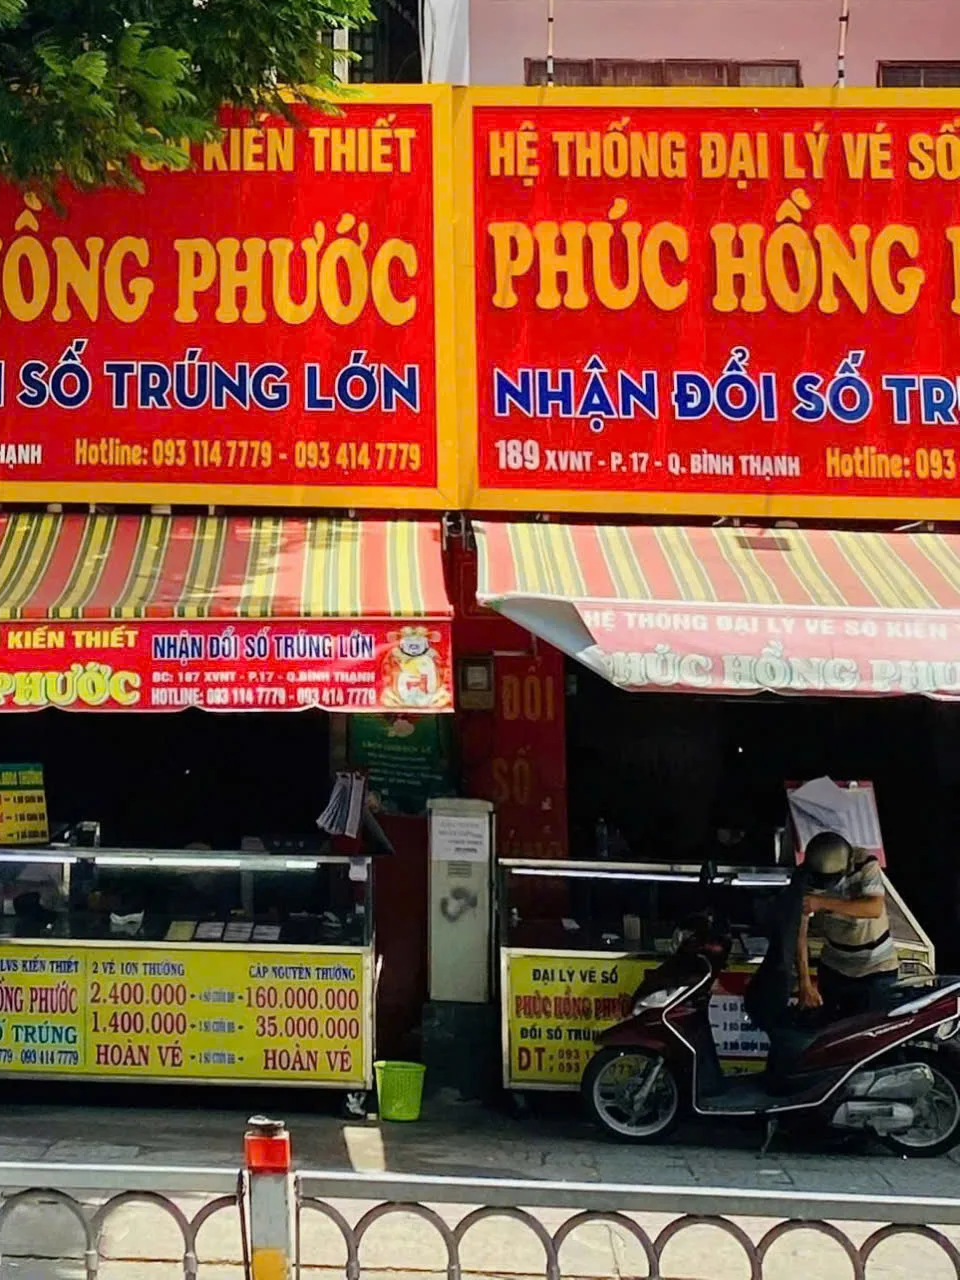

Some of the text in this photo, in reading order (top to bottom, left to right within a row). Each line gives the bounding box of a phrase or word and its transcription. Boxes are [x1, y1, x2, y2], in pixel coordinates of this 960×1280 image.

[308, 113, 416, 173] THIẾT
[489, 120, 538, 186] HỆ
[553, 117, 687, 178] THỐNG
[701, 132, 768, 189] ĐẠI
[784, 122, 829, 180] LÝ
[843, 123, 894, 180] VÉ
[487, 198, 690, 311] PHÚC
[710, 189, 926, 315] HỒNG
[172, 213, 419, 327] PHƯỚC
[17, 339, 91, 409] SỐ
[106, 348, 288, 412] TRÚNG
[305, 348, 421, 414] LỚN
[494, 347, 872, 432] NHẬN ĐỔI SỐ
[75, 438, 422, 471] Hotline: 093 114 7779 093 414 7779
[496, 440, 800, 481] 189 XVNT P. 17 Q. BÌNH THẠNH
[826, 447, 956, 480] Hotline: 093
[7, 626, 69, 650] KIẾN
[73, 625, 138, 649] THIẾT
[153, 625, 374, 666] NHẬN SỐ TRÚNG LỚN
[29, 980, 79, 1014] PHƯỚC
[90, 982, 187, 1005] 2.400.000
[246, 986, 359, 1011] 160.000.000
[11, 1020, 78, 1044] TRÚNG
[91, 1011, 187, 1035] 1.400.000
[256, 1015, 359, 1039] 35.000.000
[96, 1038, 150, 1067] HOÀN
[157, 1039, 183, 1068] VÉ
[263, 1042, 319, 1071] HOÀN
[326, 1044, 352, 1073] VÉ
